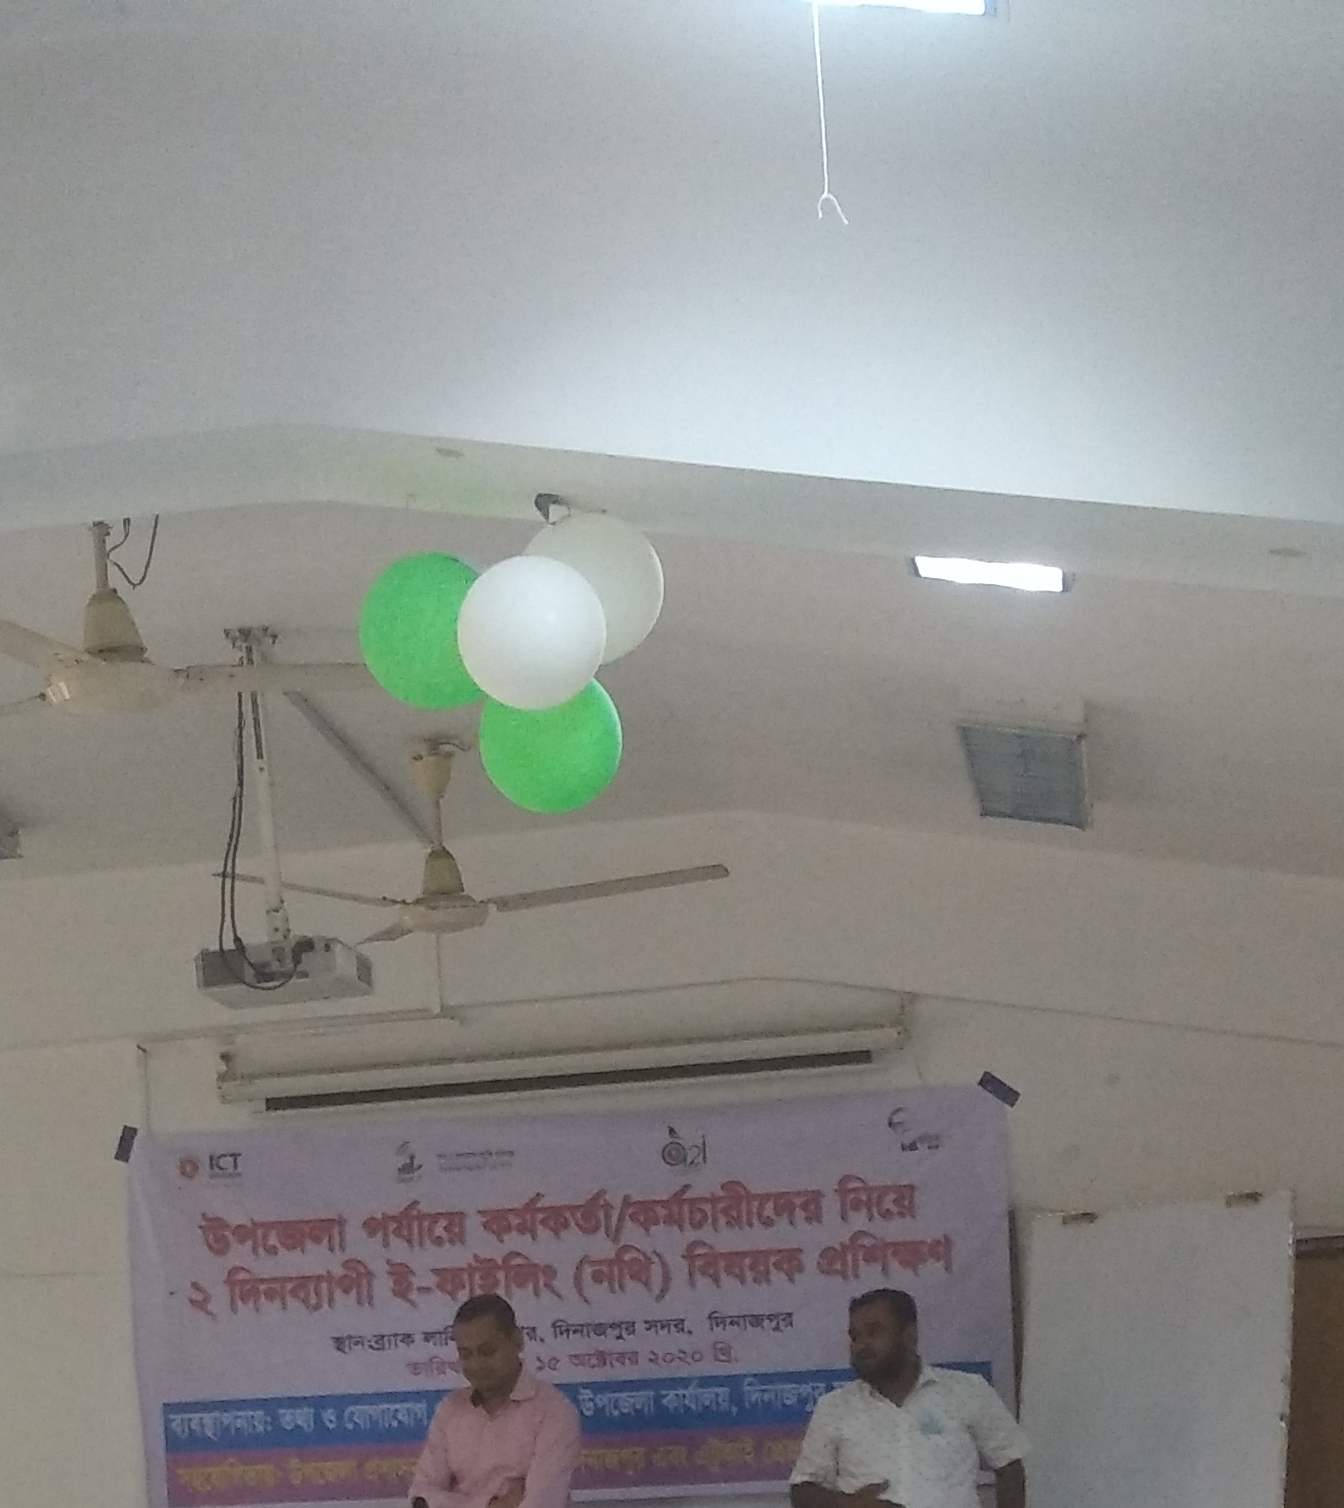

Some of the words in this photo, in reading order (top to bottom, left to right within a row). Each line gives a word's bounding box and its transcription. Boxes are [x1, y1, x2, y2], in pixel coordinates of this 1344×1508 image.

[209, 1153, 242, 1171] ICT
[199, 1212, 348, 1256] উপজেলা
[361, 1200, 468, 1249] পর্যায়ে
[478, 1180, 823, 1243] কর্মকর্তা/কর্মচারীদের
[836, 1174, 916, 1222] নিয়ে
[187, 1281, 216, 1320] ২
[223, 1259, 375, 1314] দিনব্যাপী
[574, 1243, 672, 1302] (নথি)
[682, 1239, 805, 1288] বিষয়ক
[817, 1231, 953, 1281] প্রশিক্ষণ
[550, 1319, 636, 1341] দিনাজপুর
[708, 1310, 794, 1332] দিনাজপুর
[568, 1349, 639, 1370] অক্টোবর
[648, 1348, 704, 1367] ২০২০
[278, 1407, 314, 1432] তথ্য
[321, 1408, 337, 1430] ও
[578, 1385, 655, 1417] উপজেলা
